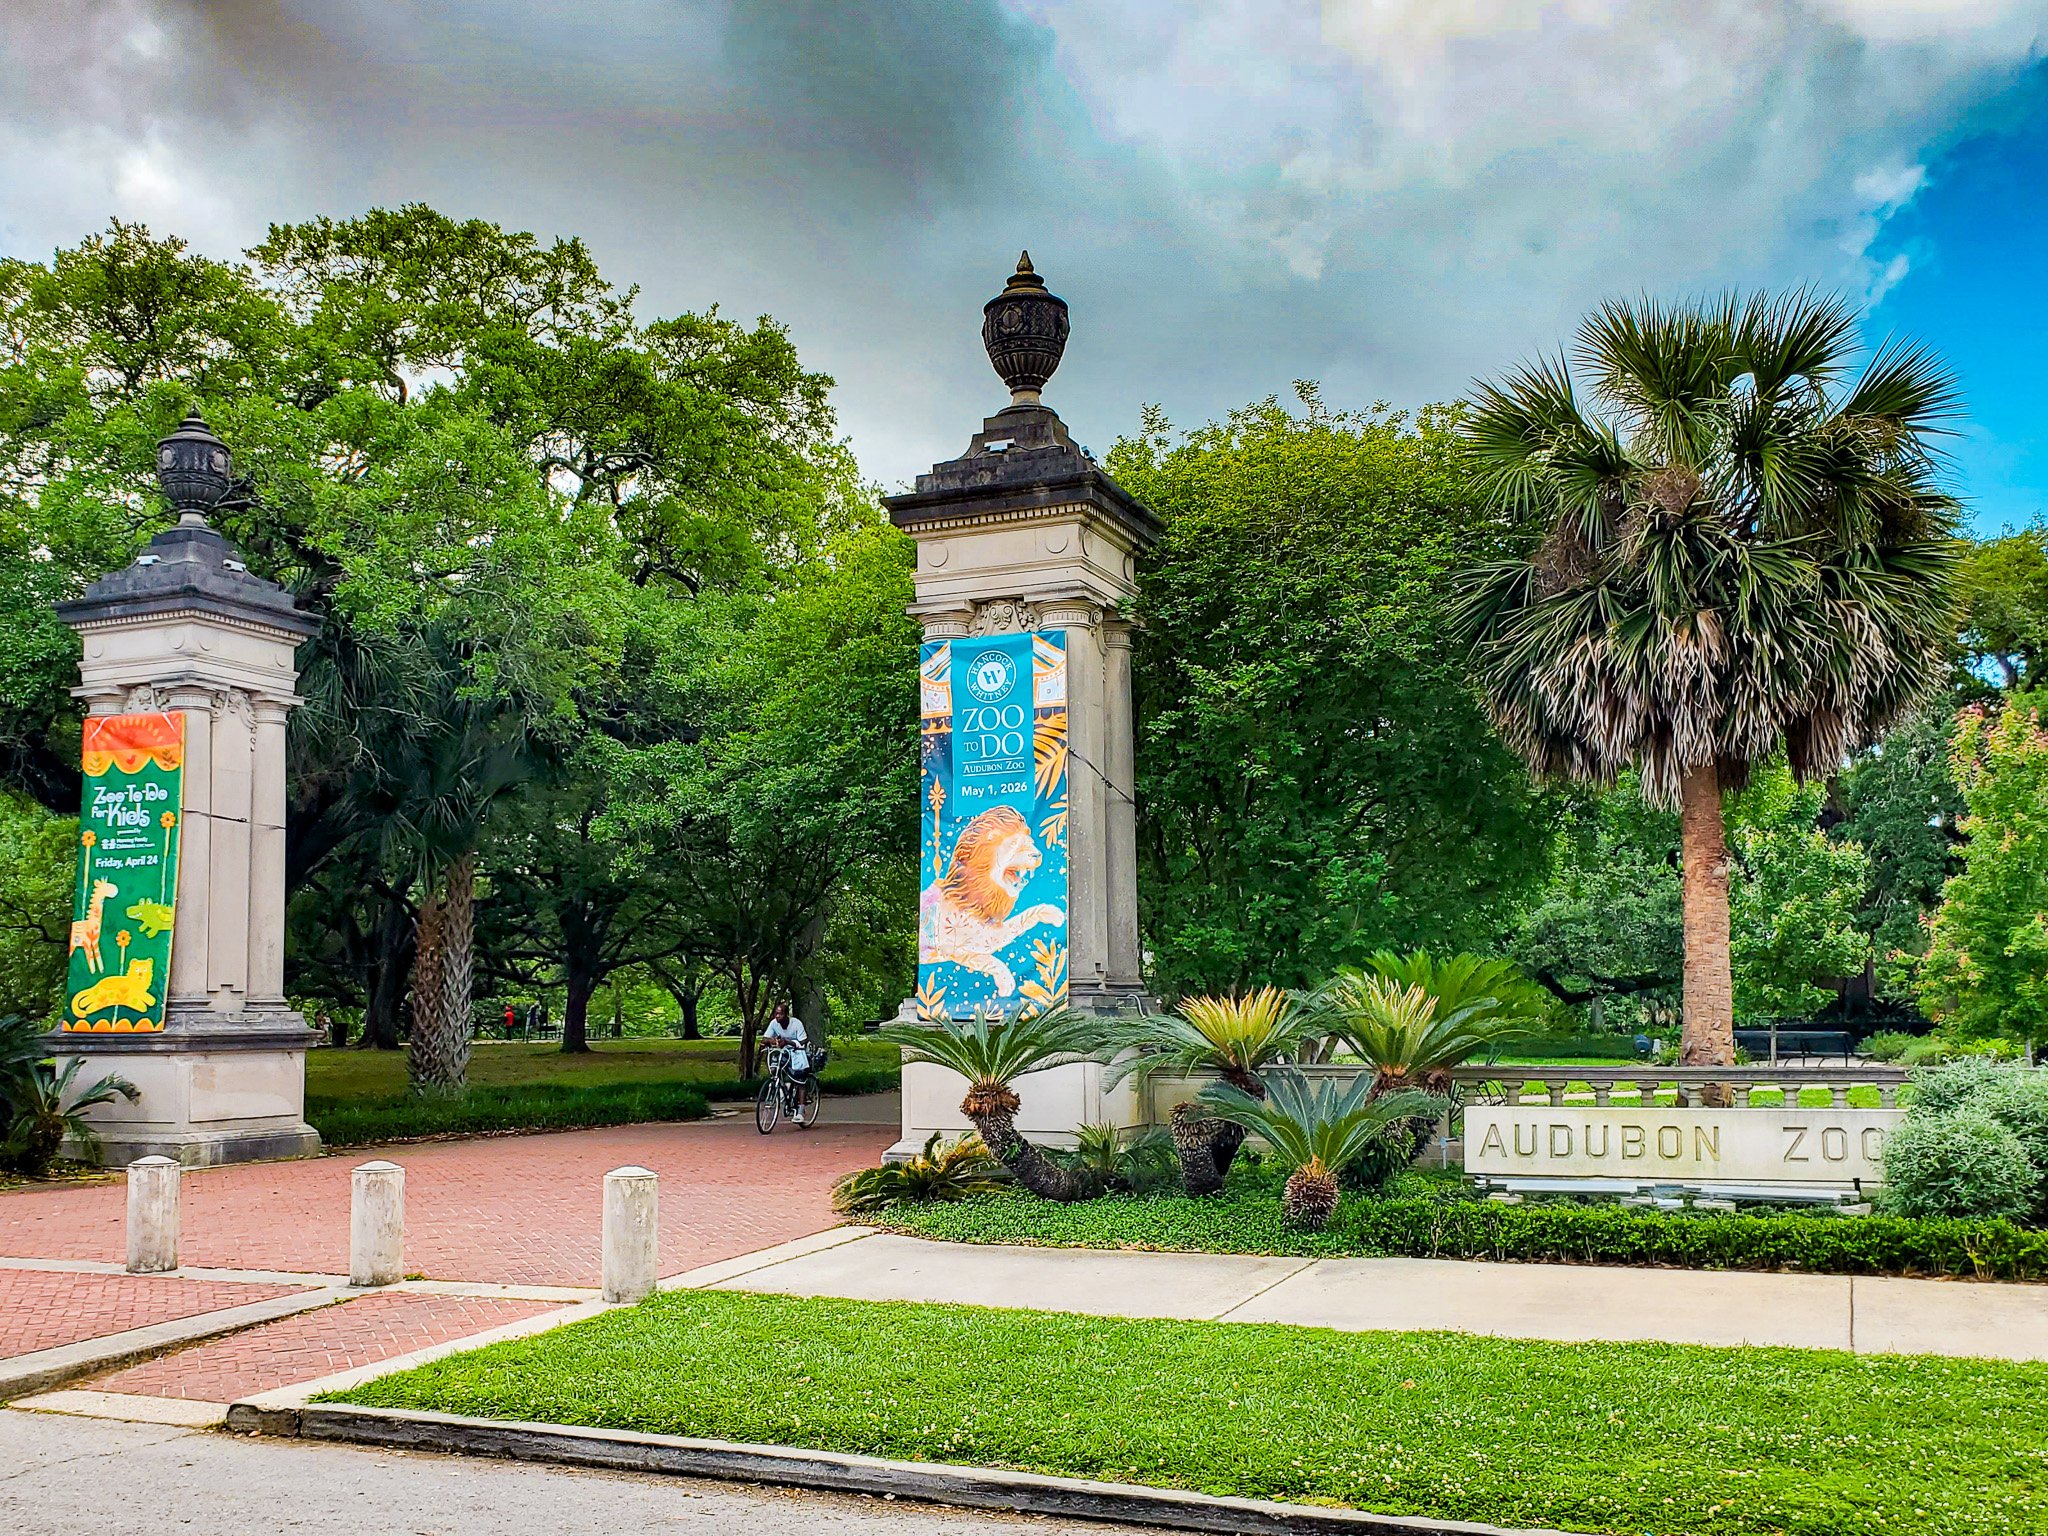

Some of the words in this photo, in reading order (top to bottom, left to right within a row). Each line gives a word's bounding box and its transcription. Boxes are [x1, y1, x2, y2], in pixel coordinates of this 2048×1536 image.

[971, 653, 1013, 675] HANCOCK
[971, 678, 1012, 700] WHITNEY
[961, 704, 1025, 733] ZOO
[964, 741, 979, 752] TO
[979, 731, 1024, 759] DO
[961, 785, 985, 798] May
[987, 784, 998, 796] 1,
[1000, 782, 1028, 794] 2026
[107, 802, 151, 827] Kids
[95, 857, 124, 869] Friday,
[125, 855, 146, 868] April
[147, 854, 159, 865] 24
[1479, 1122, 1721, 1163] AUDUBON
[1782, 1126, 1886, 1164] ZOO
